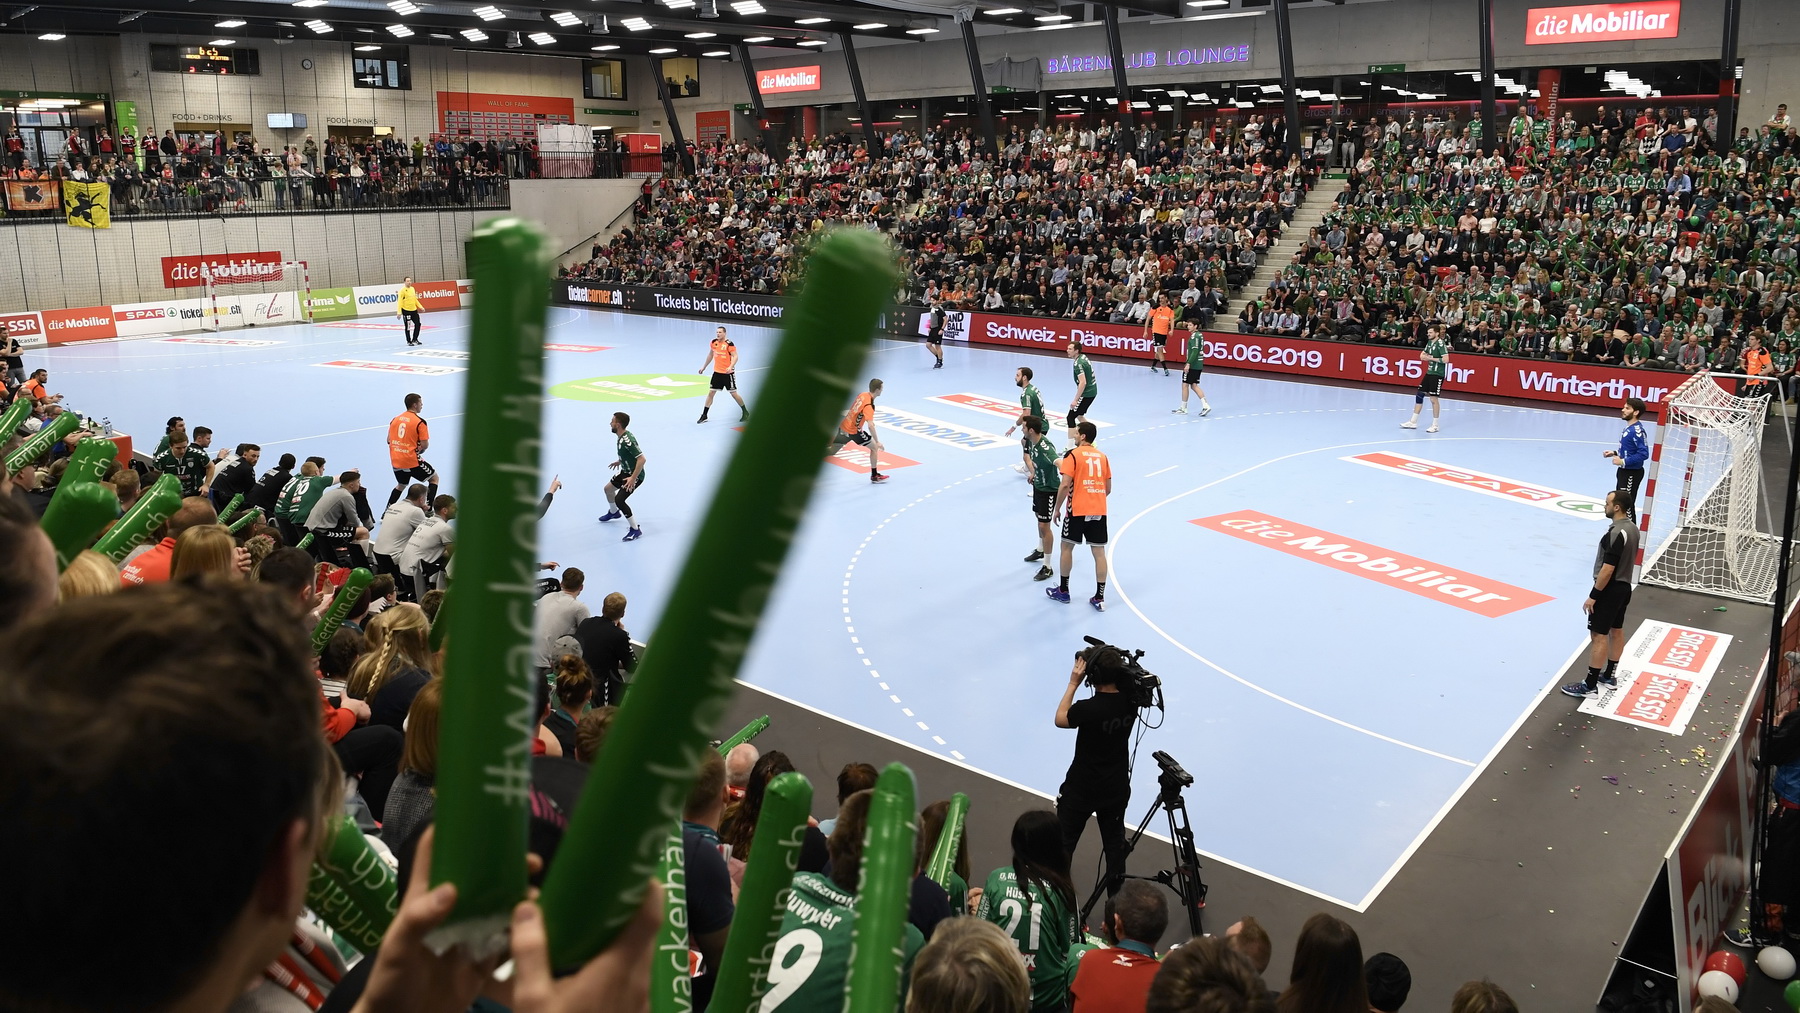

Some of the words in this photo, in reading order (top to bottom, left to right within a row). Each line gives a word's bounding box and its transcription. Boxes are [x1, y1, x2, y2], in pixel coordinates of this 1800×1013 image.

[1535, 15, 1568, 36] die
[1570, 10, 1670, 34] Mobiliar
[1047, 52, 1157, 74] BÄRENLUB
[1167, 45, 1250, 66] LOUNGE
[760, 76, 775, 89] die
[775, 72, 817, 87] Mobiliar
[1546, 81, 1559, 126] Mobiliar
[170, 262, 198, 280] die
[358, 294, 399, 305] CONCORDI
[423, 289, 455, 299] Mobiliar
[568, 284, 623, 306] ticketcorner.ch
[126, 308, 166, 320] SPAR
[654, 293, 691, 310] Tickets
[693, 296, 710, 312] bei
[711, 297, 784, 318] Ticketcorner
[8, 318, 37, 332] SSR
[48, 318, 64, 331] die
[65, 316, 110, 329] Mobiliar
[948, 312, 964, 322] AND
[986, 322, 1056, 344] Schweiz
[1070, 328, 1167, 354] Dänemar
[1201, 340, 1323, 368] 05.06.2019
[1362, 355, 1422, 380] 18.15
[1444, 362, 1475, 384] hr
[1518, 369, 1668, 403] Winterthur
[588, 380, 675, 397] erima
[398, 422, 406, 439] 6
[874, 410, 998, 448] ONCORDIA
[176, 466, 186, 475] 17
[1085, 457, 1102, 478] 11
[1396, 462, 1553, 502] SPAR
[1220, 518, 1295, 540] die
[1283, 536, 1512, 604] Mobiliar
[1670, 631, 1706, 652] SRG
[1662, 648, 1696, 668] SSR
[1642, 676, 1679, 700] SRG
[1629, 696, 1667, 720] SSR
[999, 898, 1043, 951] 21
[758, 928, 824, 1013] 9
